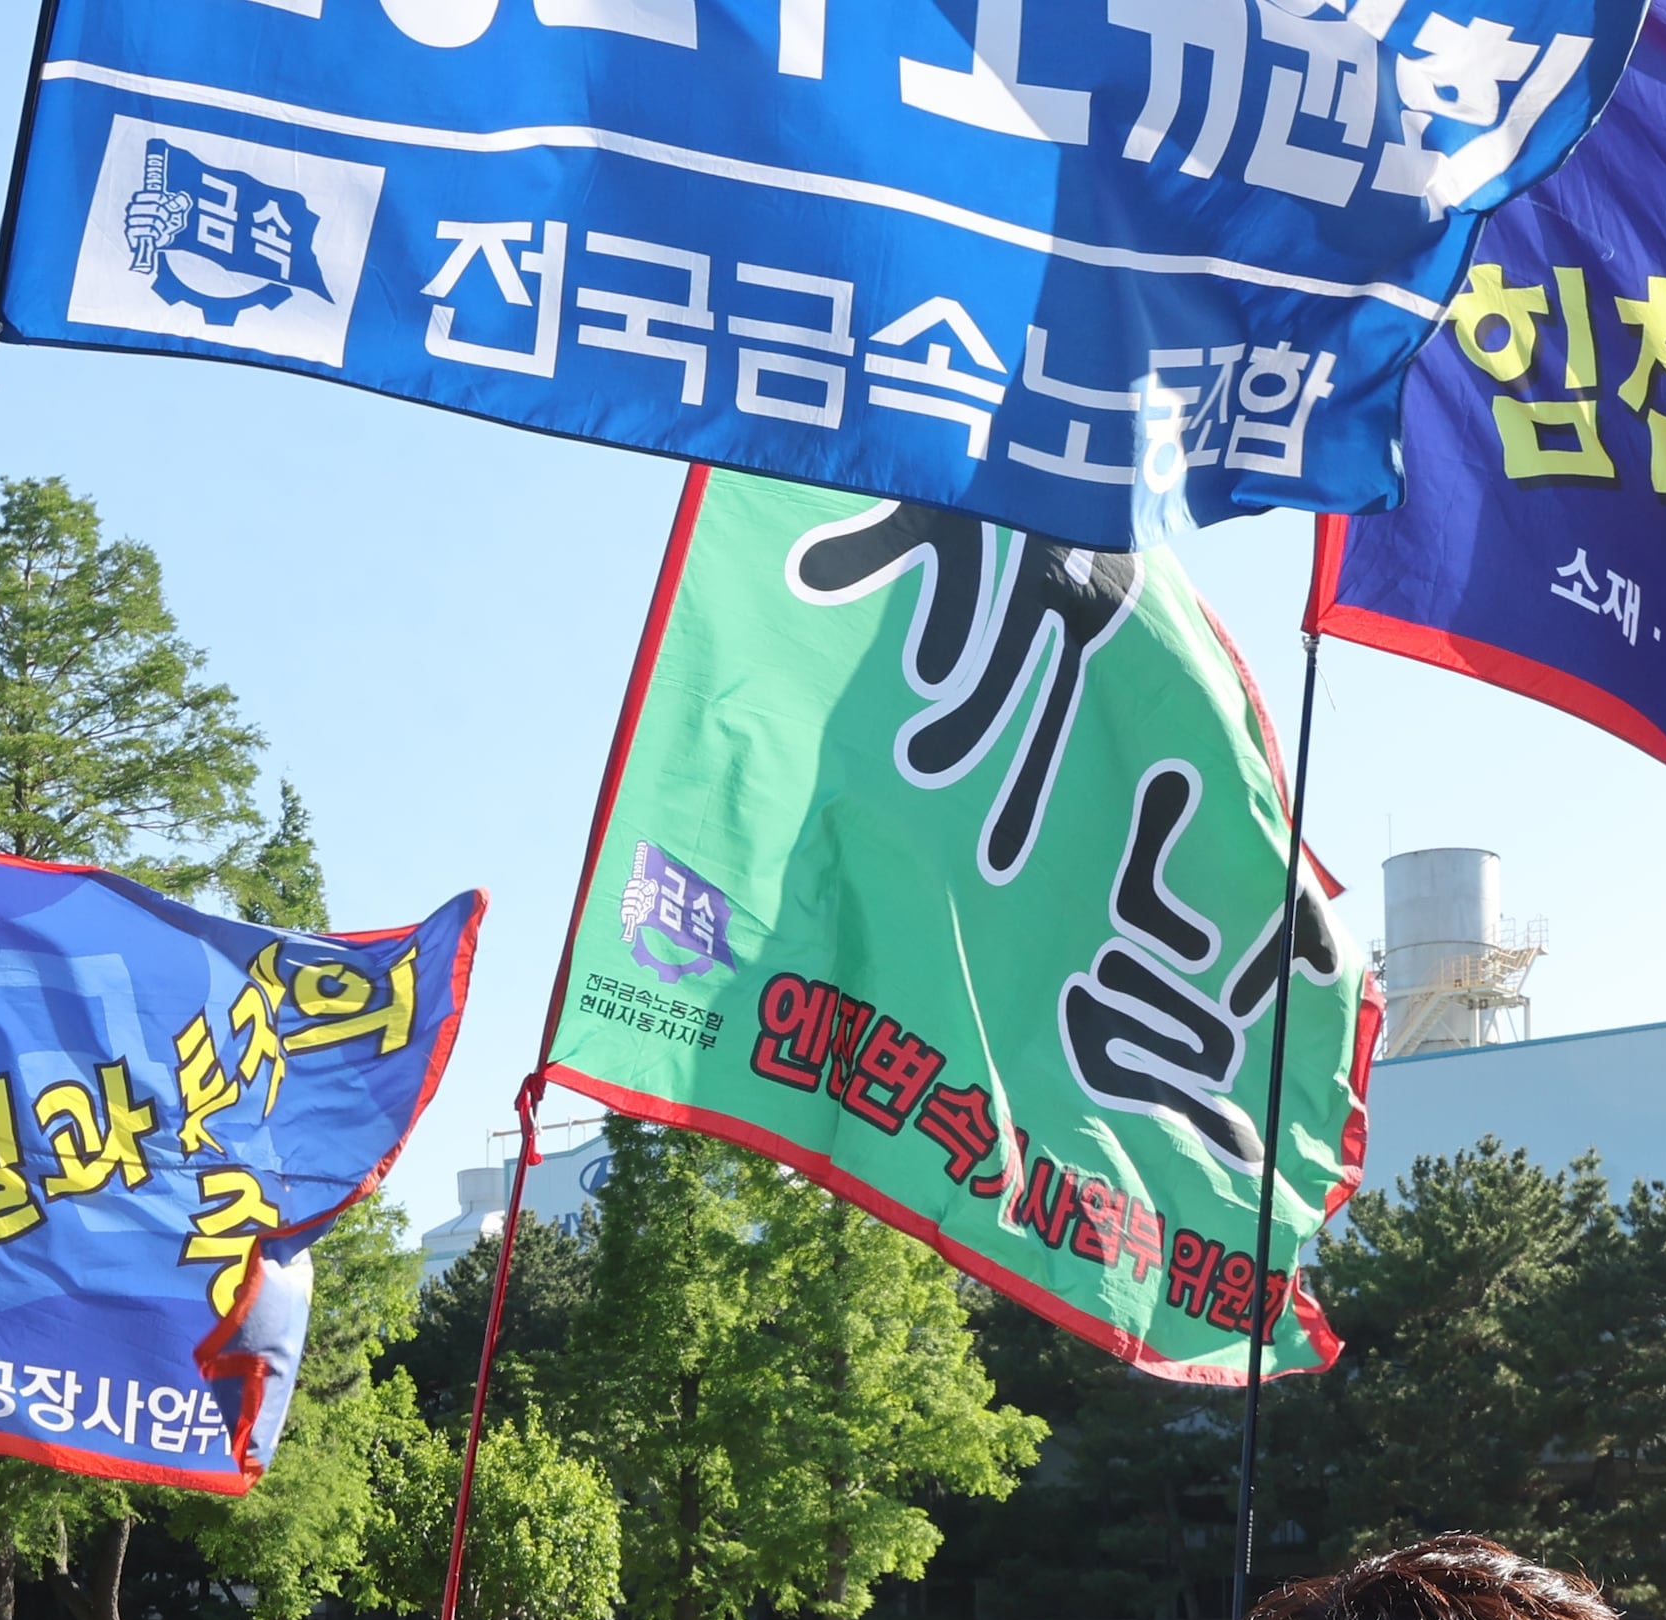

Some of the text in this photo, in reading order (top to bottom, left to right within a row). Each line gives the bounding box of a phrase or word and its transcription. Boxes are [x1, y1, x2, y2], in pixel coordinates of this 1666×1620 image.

[196, 172, 296, 284] 금속
[660, 866, 716, 955] 금속
[580, 994, 717, 1050] 현대자동차지부
[586, 973, 724, 1031] 전국금속노동조합
